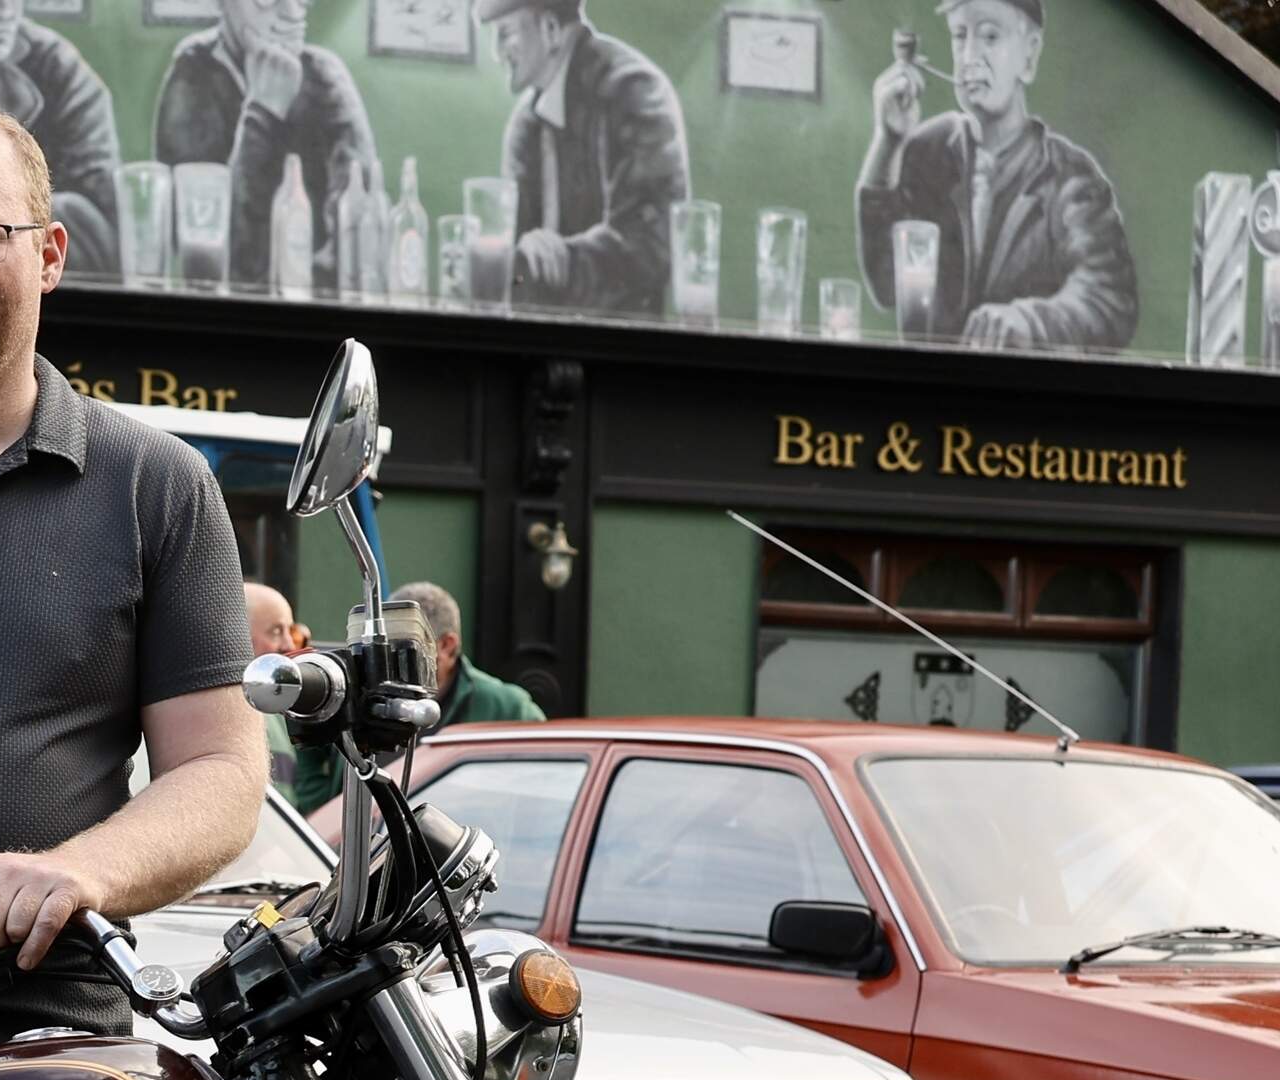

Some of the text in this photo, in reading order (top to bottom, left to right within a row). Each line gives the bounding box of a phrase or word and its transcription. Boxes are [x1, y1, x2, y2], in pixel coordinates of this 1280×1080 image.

[139, 367, 238, 412] Bar
[775, 415, 1189, 487] Bar & Restaurant
